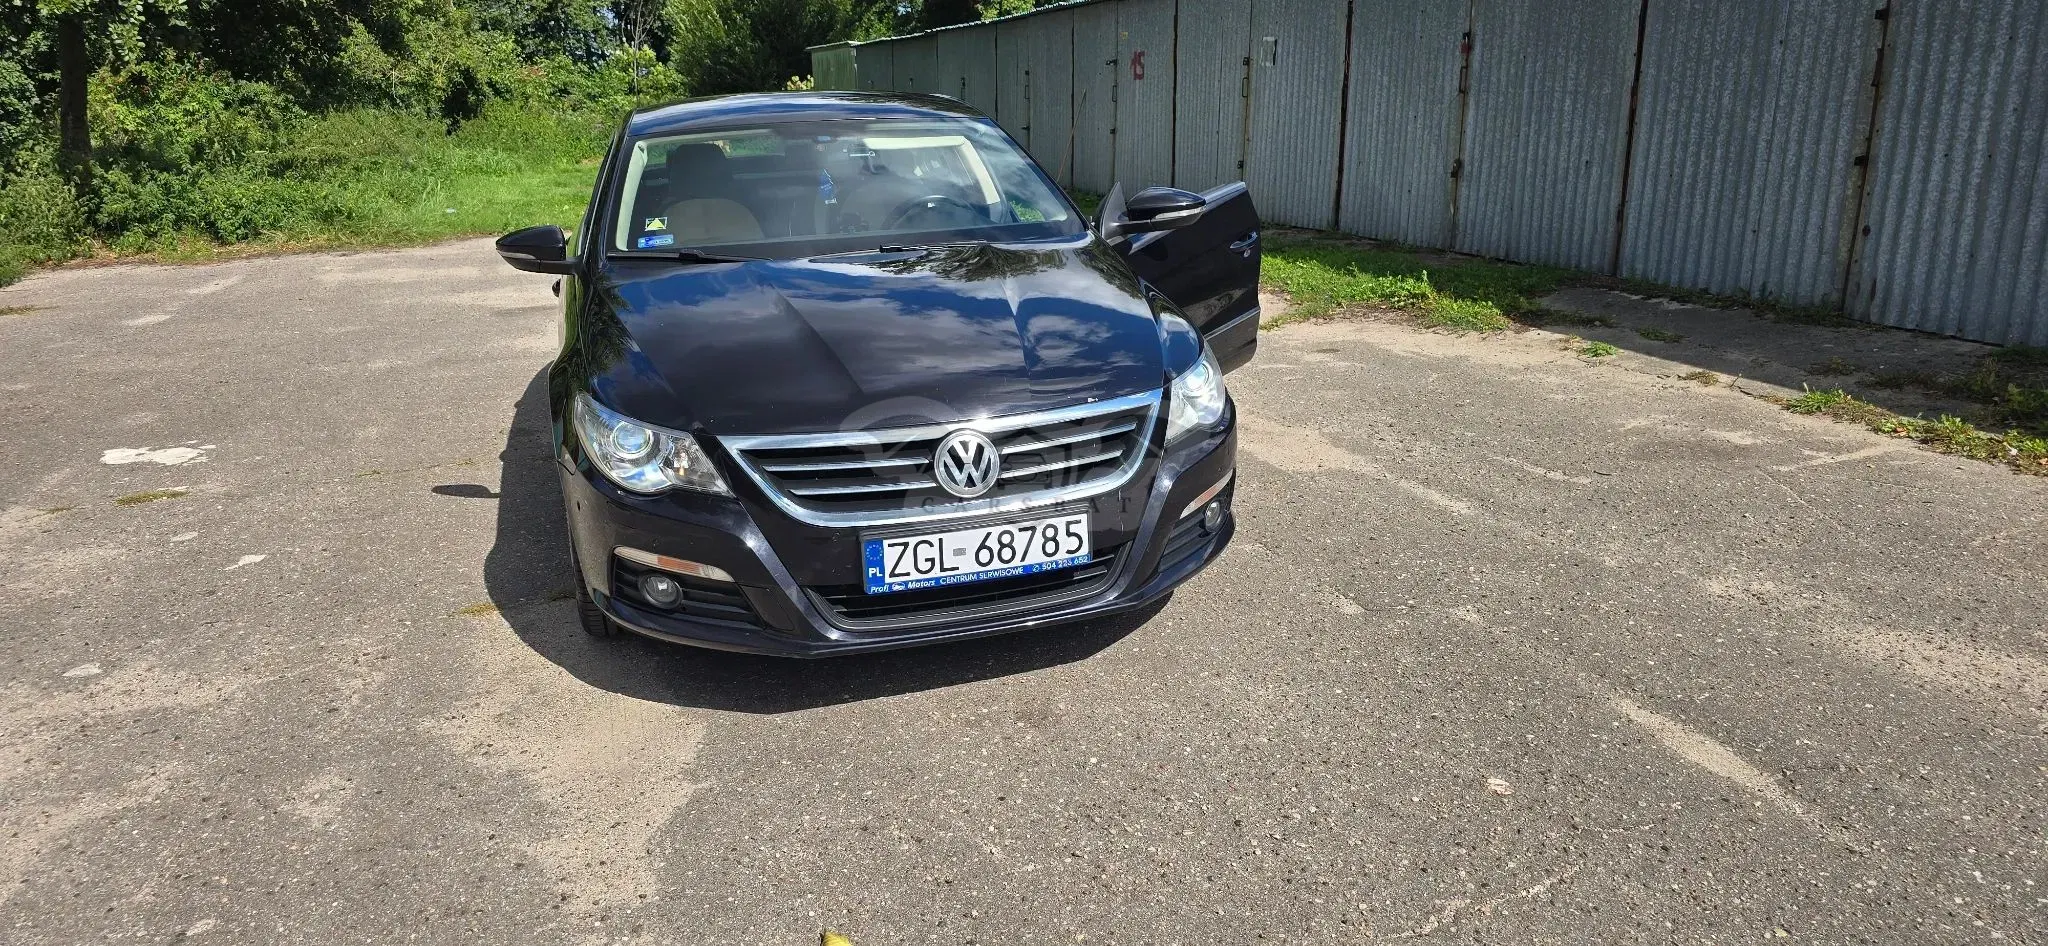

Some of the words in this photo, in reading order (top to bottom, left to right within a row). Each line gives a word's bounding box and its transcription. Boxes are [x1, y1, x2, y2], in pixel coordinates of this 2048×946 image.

[942, 438, 993, 489] VW
[887, 537, 960, 578] ZGL
[974, 518, 1084, 567] 68785
[868, 567, 883, 578] PL
[907, 579, 936, 589] Motors
[939, 573, 978, 585] CENTRUM
